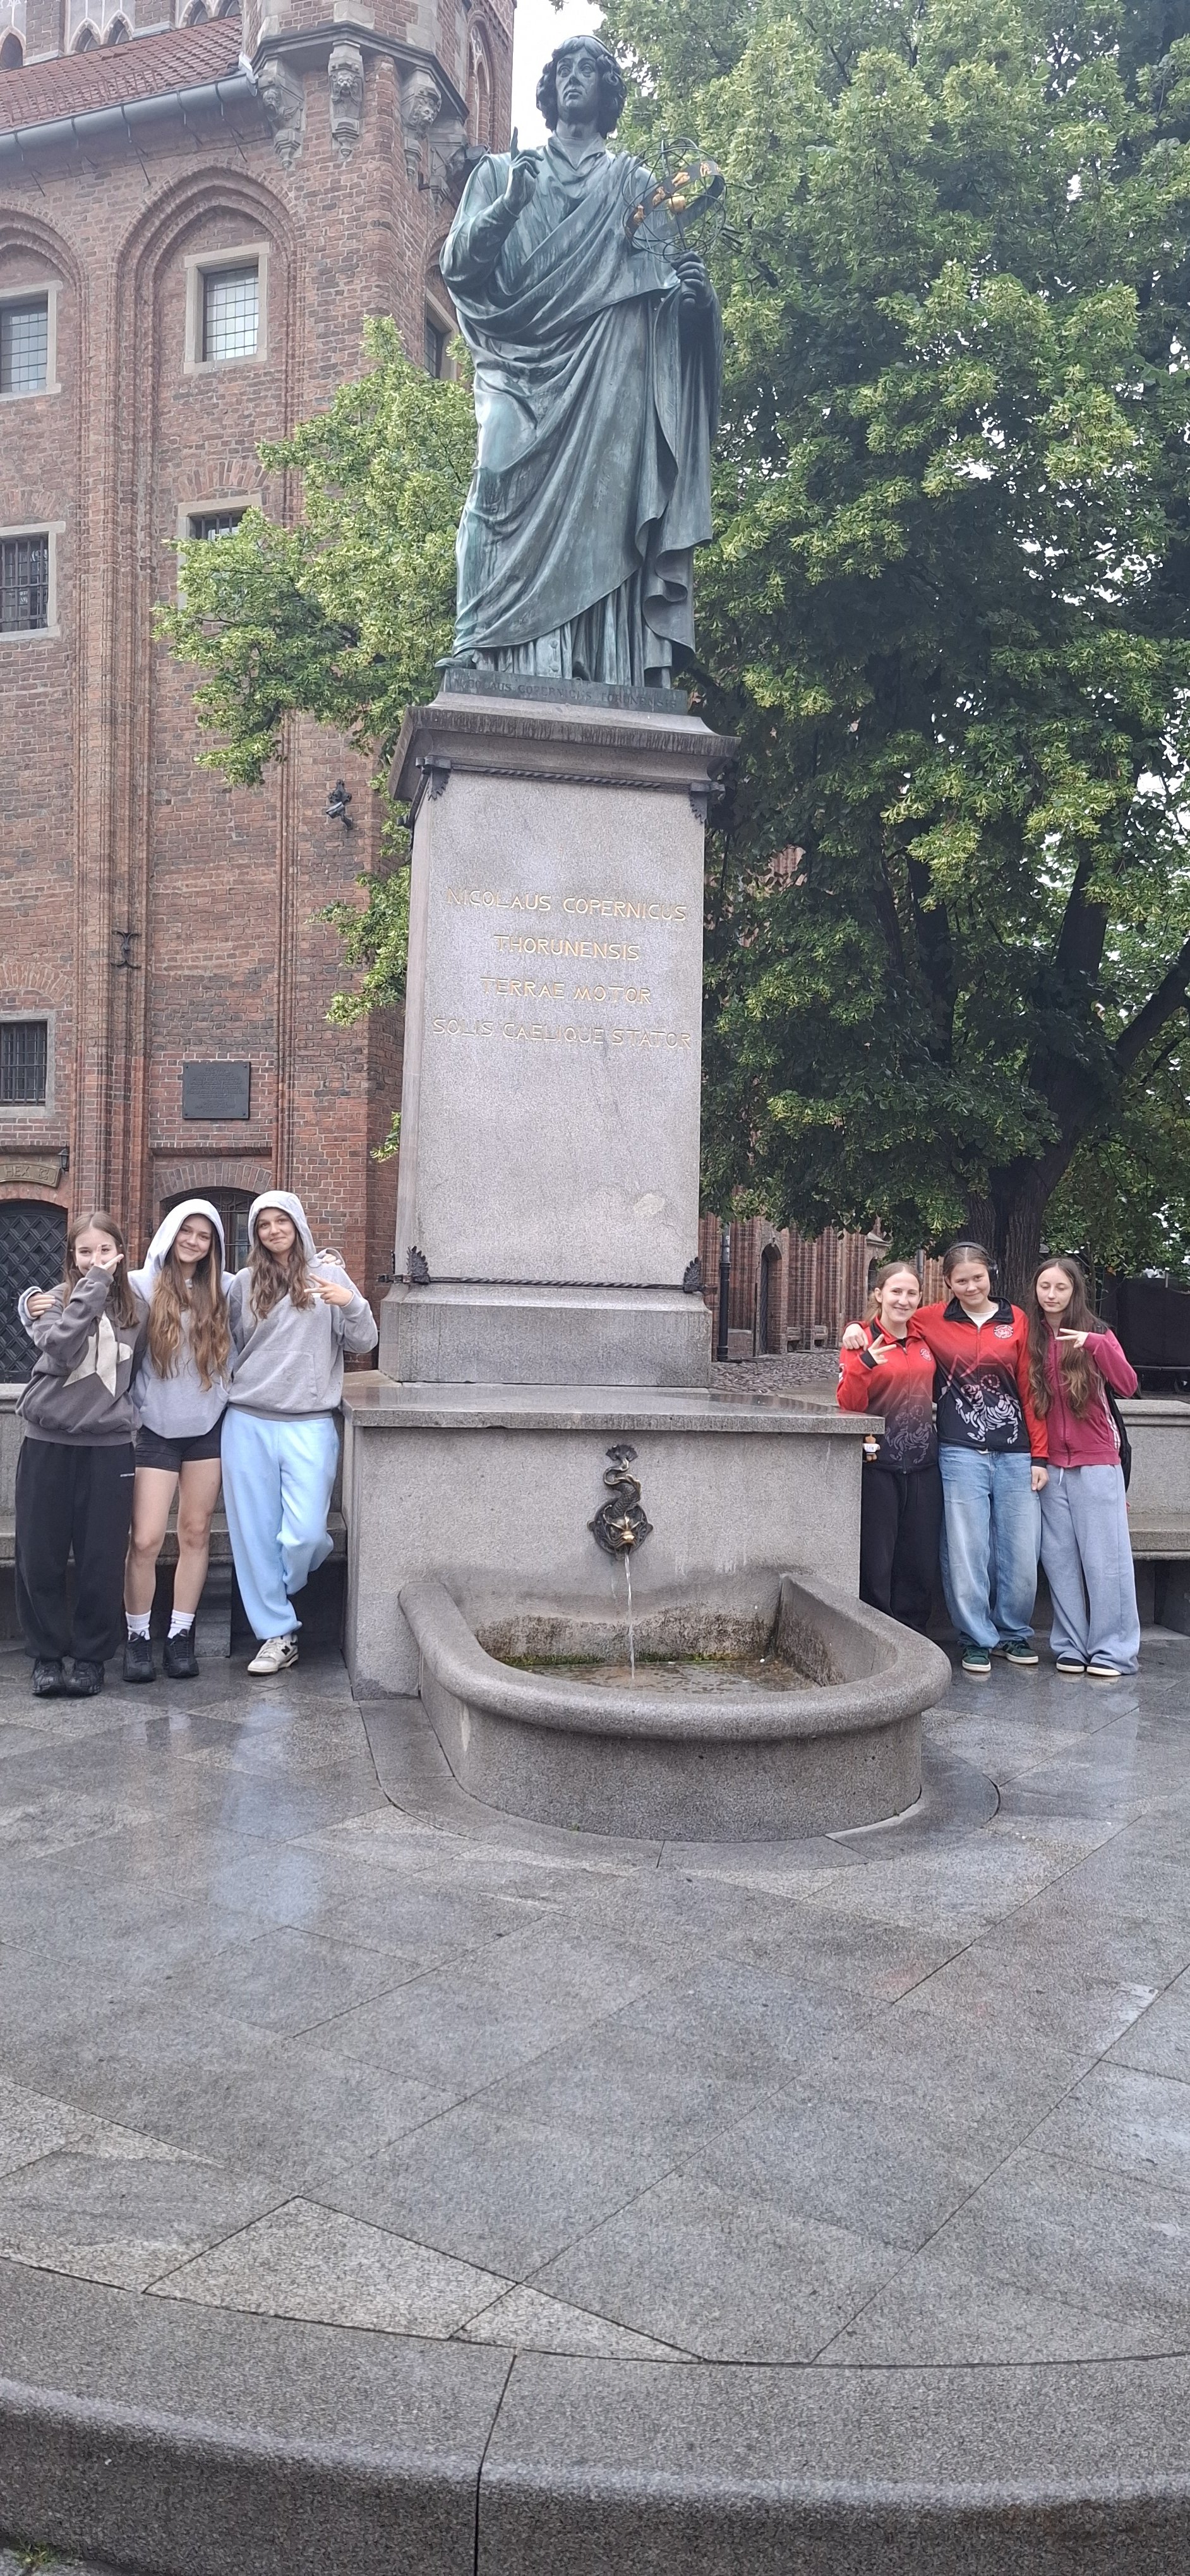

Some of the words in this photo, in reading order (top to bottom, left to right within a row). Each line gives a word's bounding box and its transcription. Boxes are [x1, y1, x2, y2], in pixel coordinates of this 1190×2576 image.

[447, 886, 551, 911] NICOLAUS
[563, 897, 687, 921] COPERNICUS
[493, 934, 640, 960] THORUNENSIS
[480, 977, 565, 999] TERRAE
[574, 985, 652, 1005] MOTOR
[433, 1018, 494, 1037] SOLIS
[503, 1022, 604, 1044] CAELIQUE
[612, 1029, 692, 1049] STATOR
